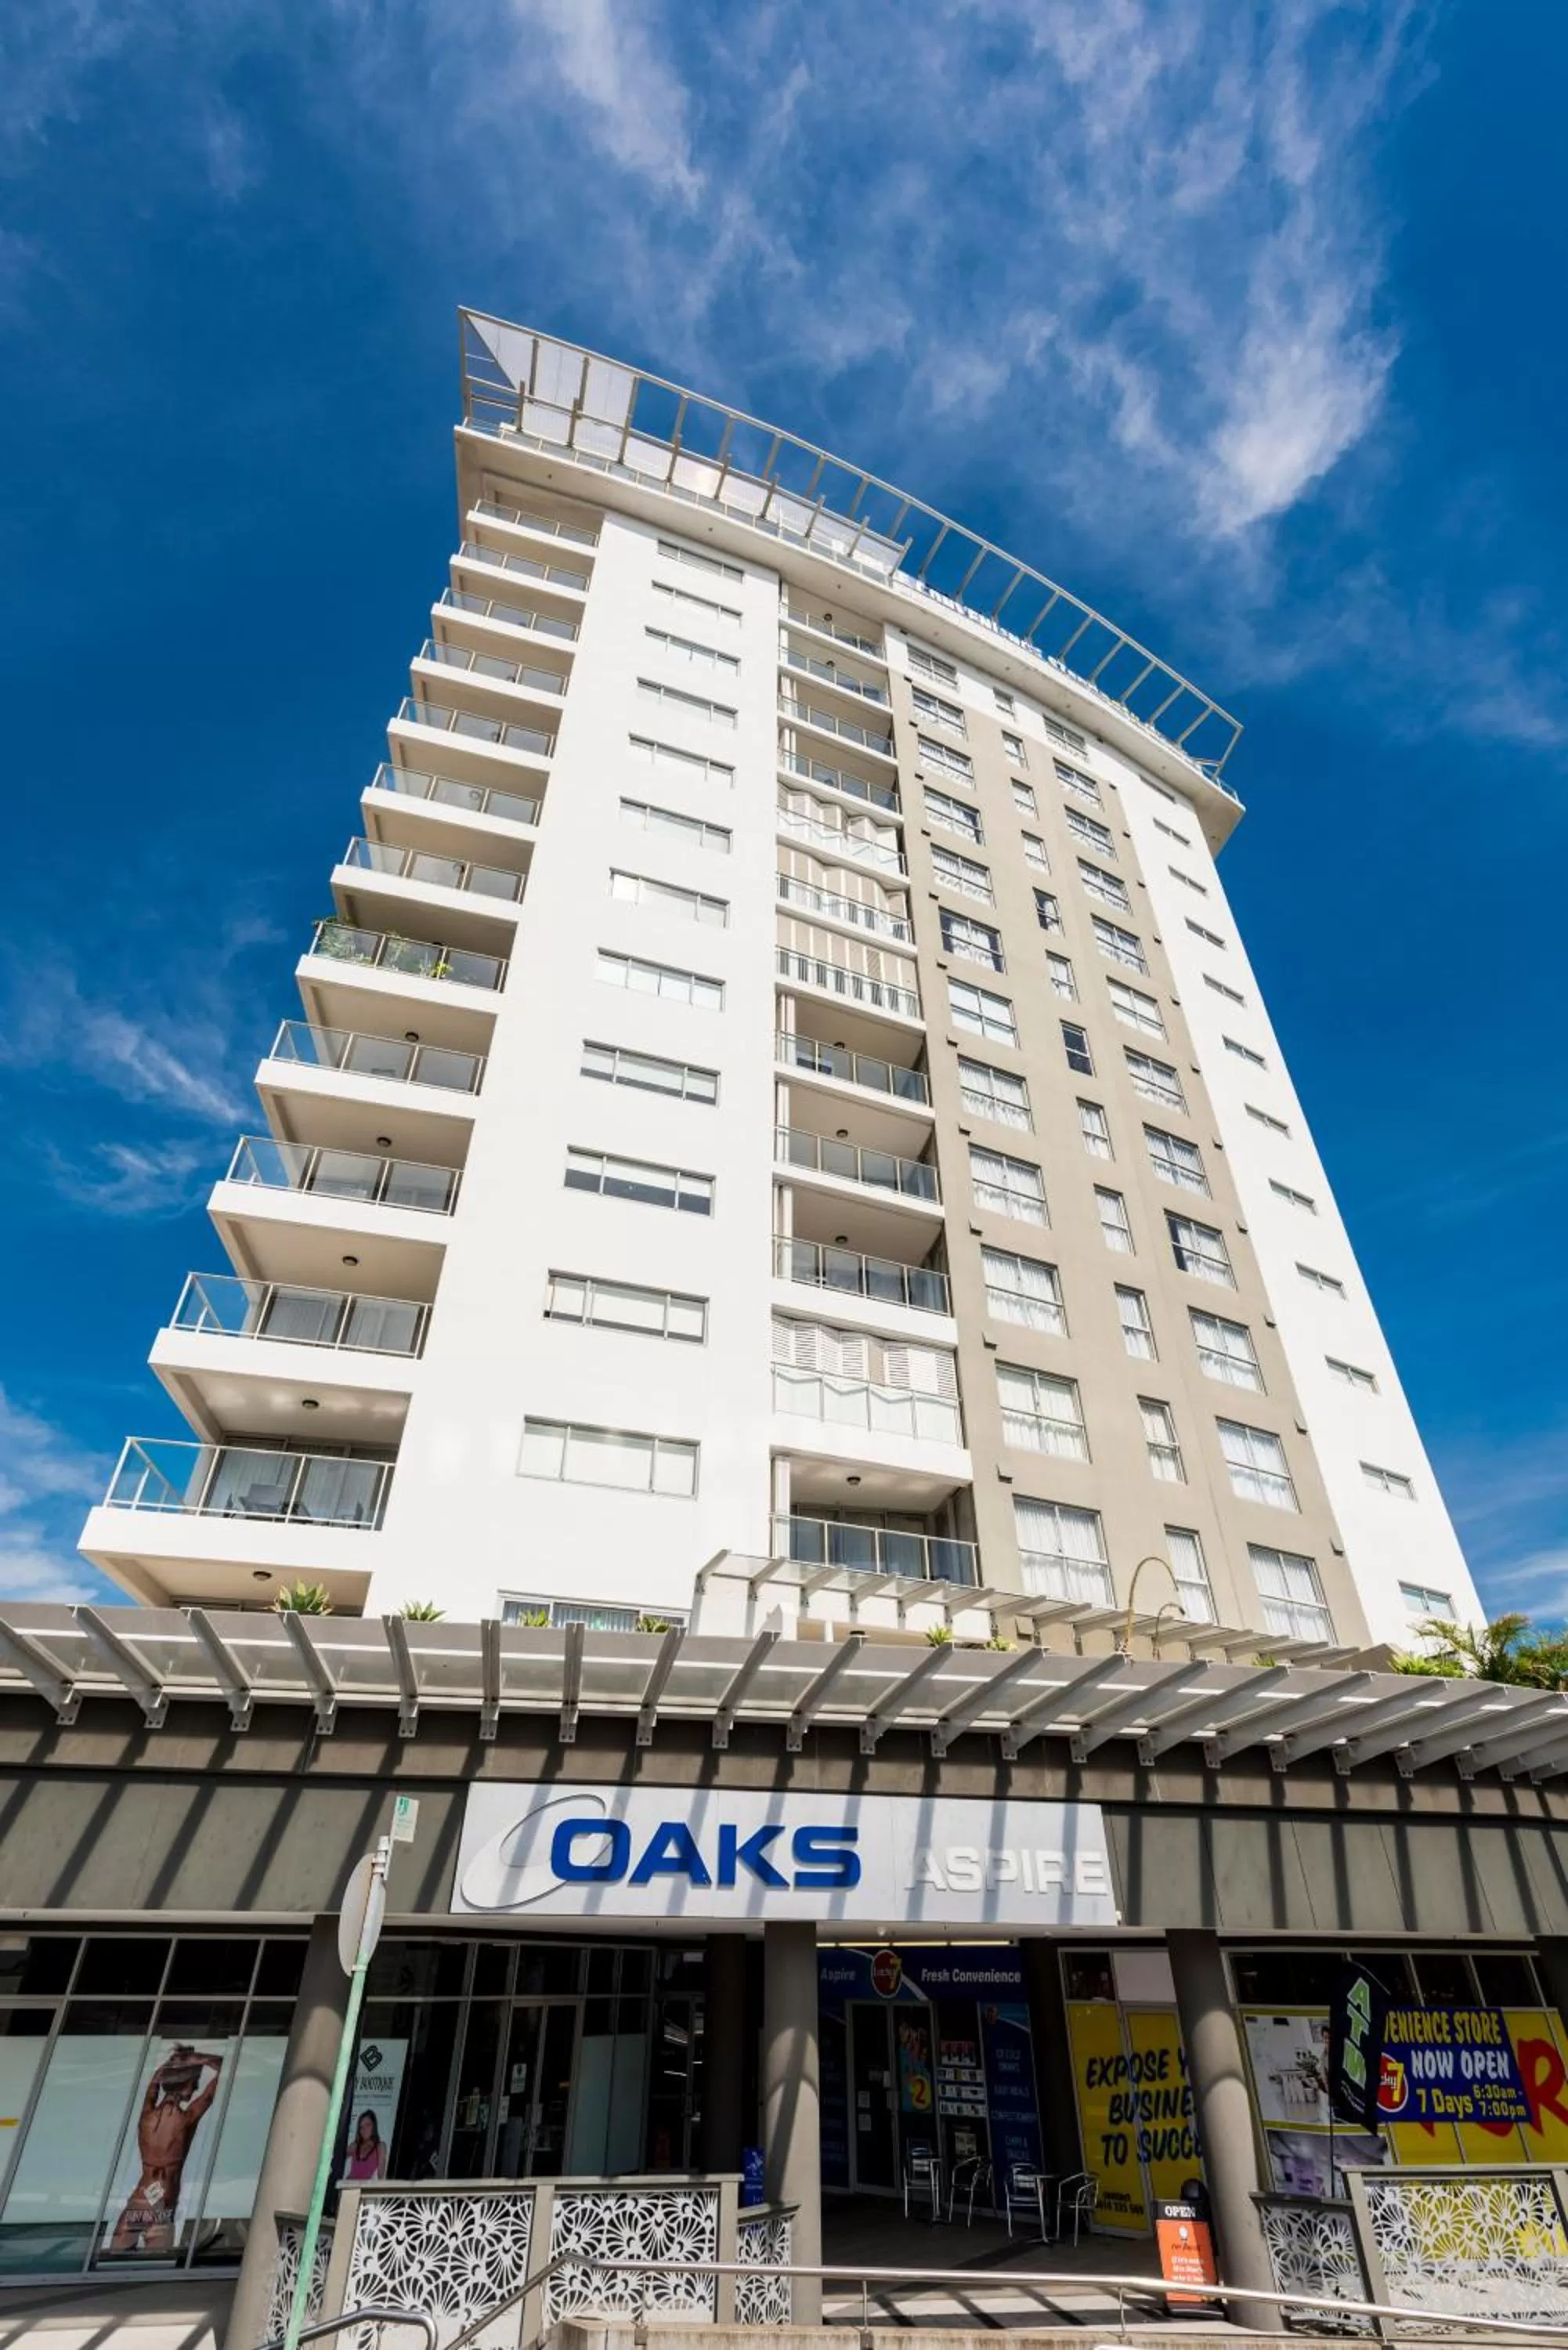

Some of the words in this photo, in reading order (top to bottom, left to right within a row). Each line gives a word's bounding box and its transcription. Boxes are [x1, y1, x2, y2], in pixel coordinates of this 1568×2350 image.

[550, 1817, 862, 1890] OAKS
[904, 1846, 1111, 1896] ASPIRE
[820, 1967, 857, 1985] Aspire
[921, 1968, 950, 1983] Fresh
[952, 1968, 1022, 1983] Convenience
[1342, 1976, 1371, 2091] ATM
[1453, 2011, 1503, 2045] STORE
[1086, 2047, 1170, 2090] EXPOSE
[1411, 2049, 1454, 2080] NOW
[1460, 2049, 1511, 2080] OPEN
[1108, 2084, 1196, 2126] BUSINE
[1415, 2088, 1427, 2114] 7
[1431, 2088, 1473, 2120] Days
[1479, 2101, 1526, 2117] 7:00pm
[1100, 2132, 1129, 2168] TO
[1165, 2205, 1196, 2218] OPEN
